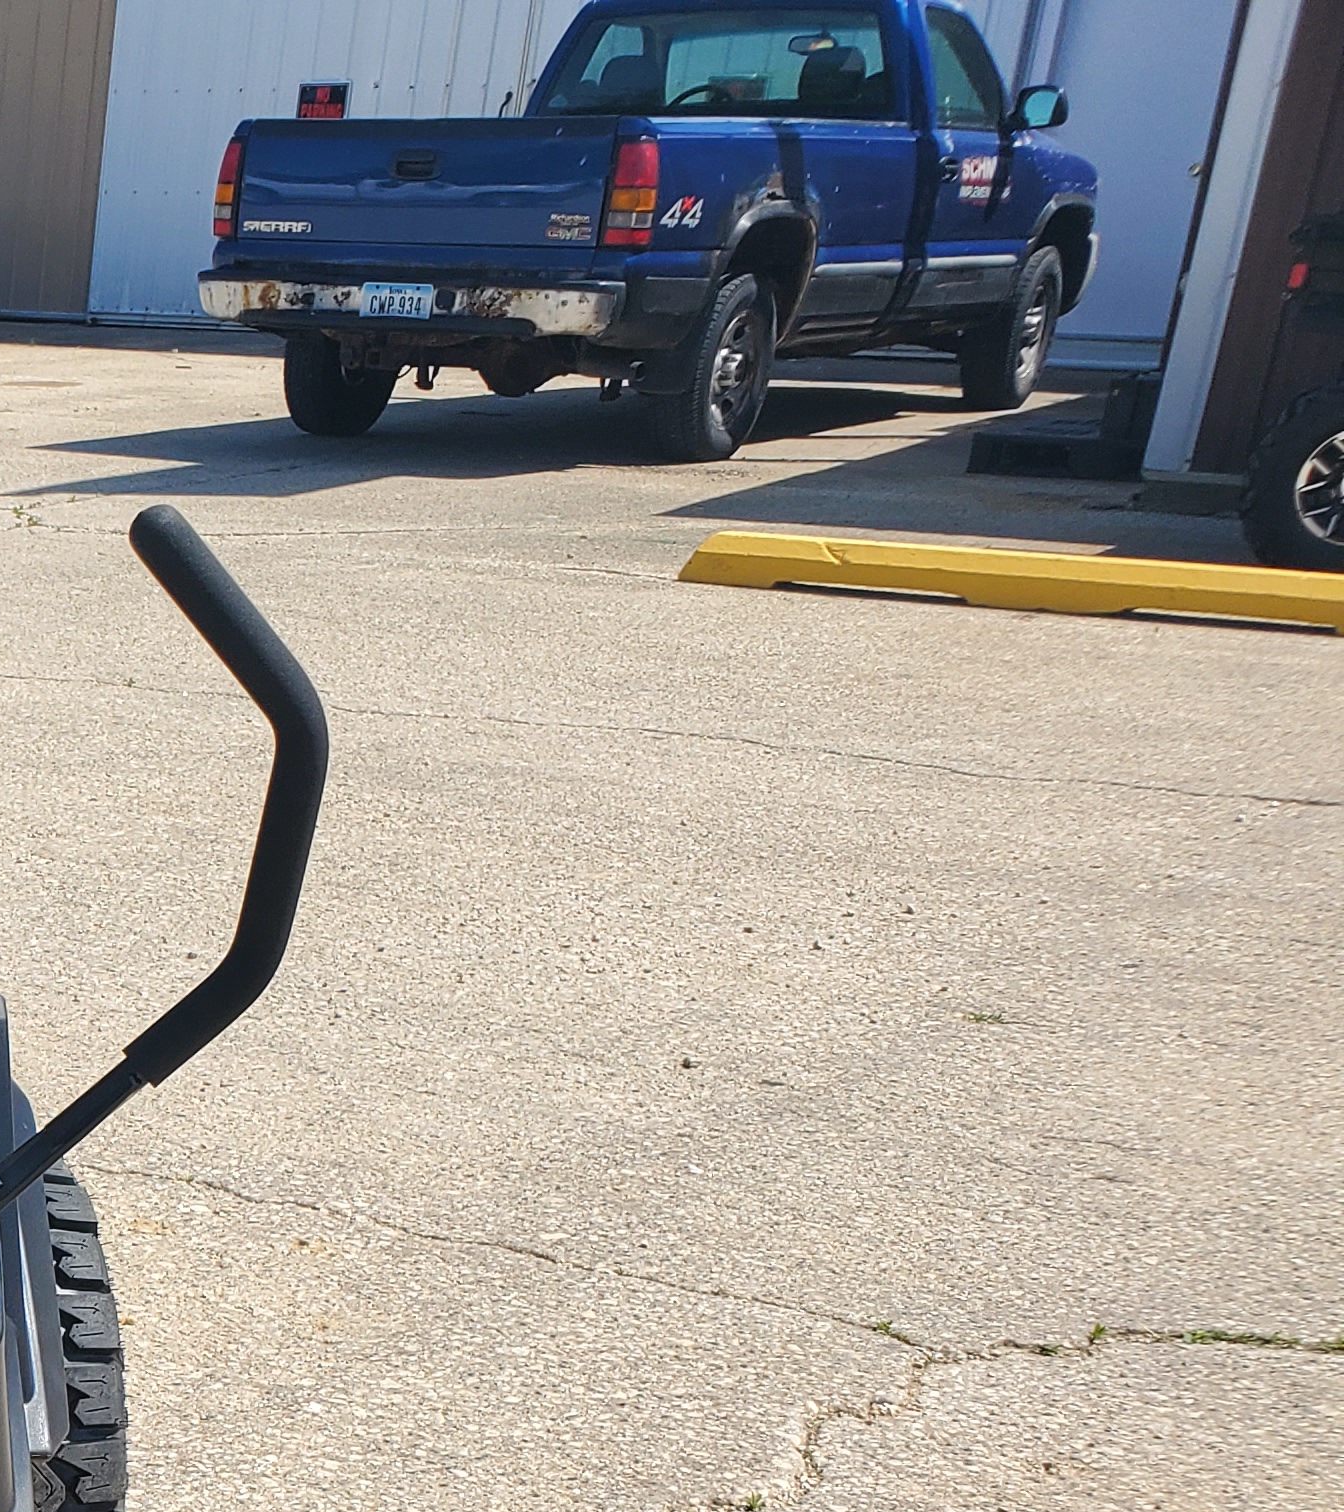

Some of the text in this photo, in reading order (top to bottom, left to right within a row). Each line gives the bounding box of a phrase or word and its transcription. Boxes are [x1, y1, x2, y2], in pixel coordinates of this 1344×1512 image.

[243, 220, 312, 233] SIERRA
[546, 226, 592, 241] GMC
[369, 295, 422, 315] CWP 934
